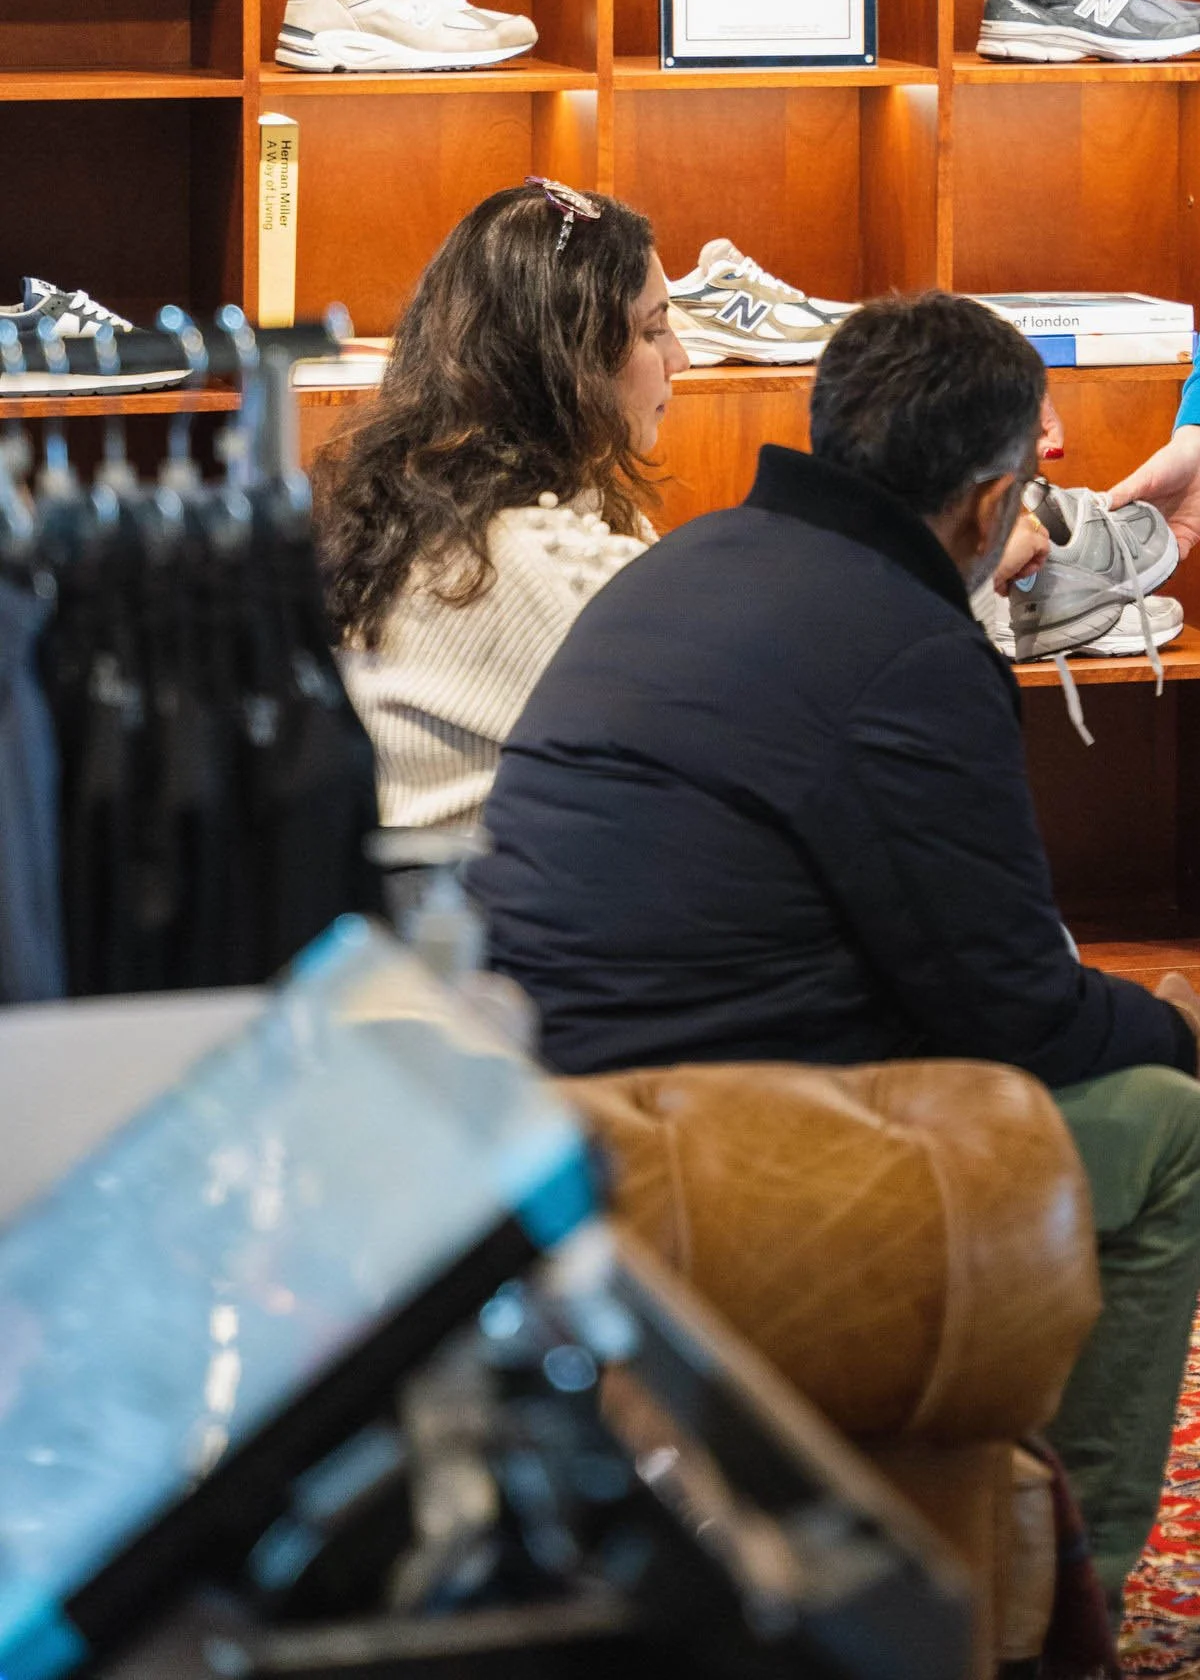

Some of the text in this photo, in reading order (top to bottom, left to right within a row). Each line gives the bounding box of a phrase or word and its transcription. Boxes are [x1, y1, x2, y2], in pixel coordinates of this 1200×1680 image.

[262, 140, 277, 231] A Way of Living
[279, 140, 292, 227] Herman Miller
[716, 290, 773, 333] N
[1013, 315, 1080, 329] of london
